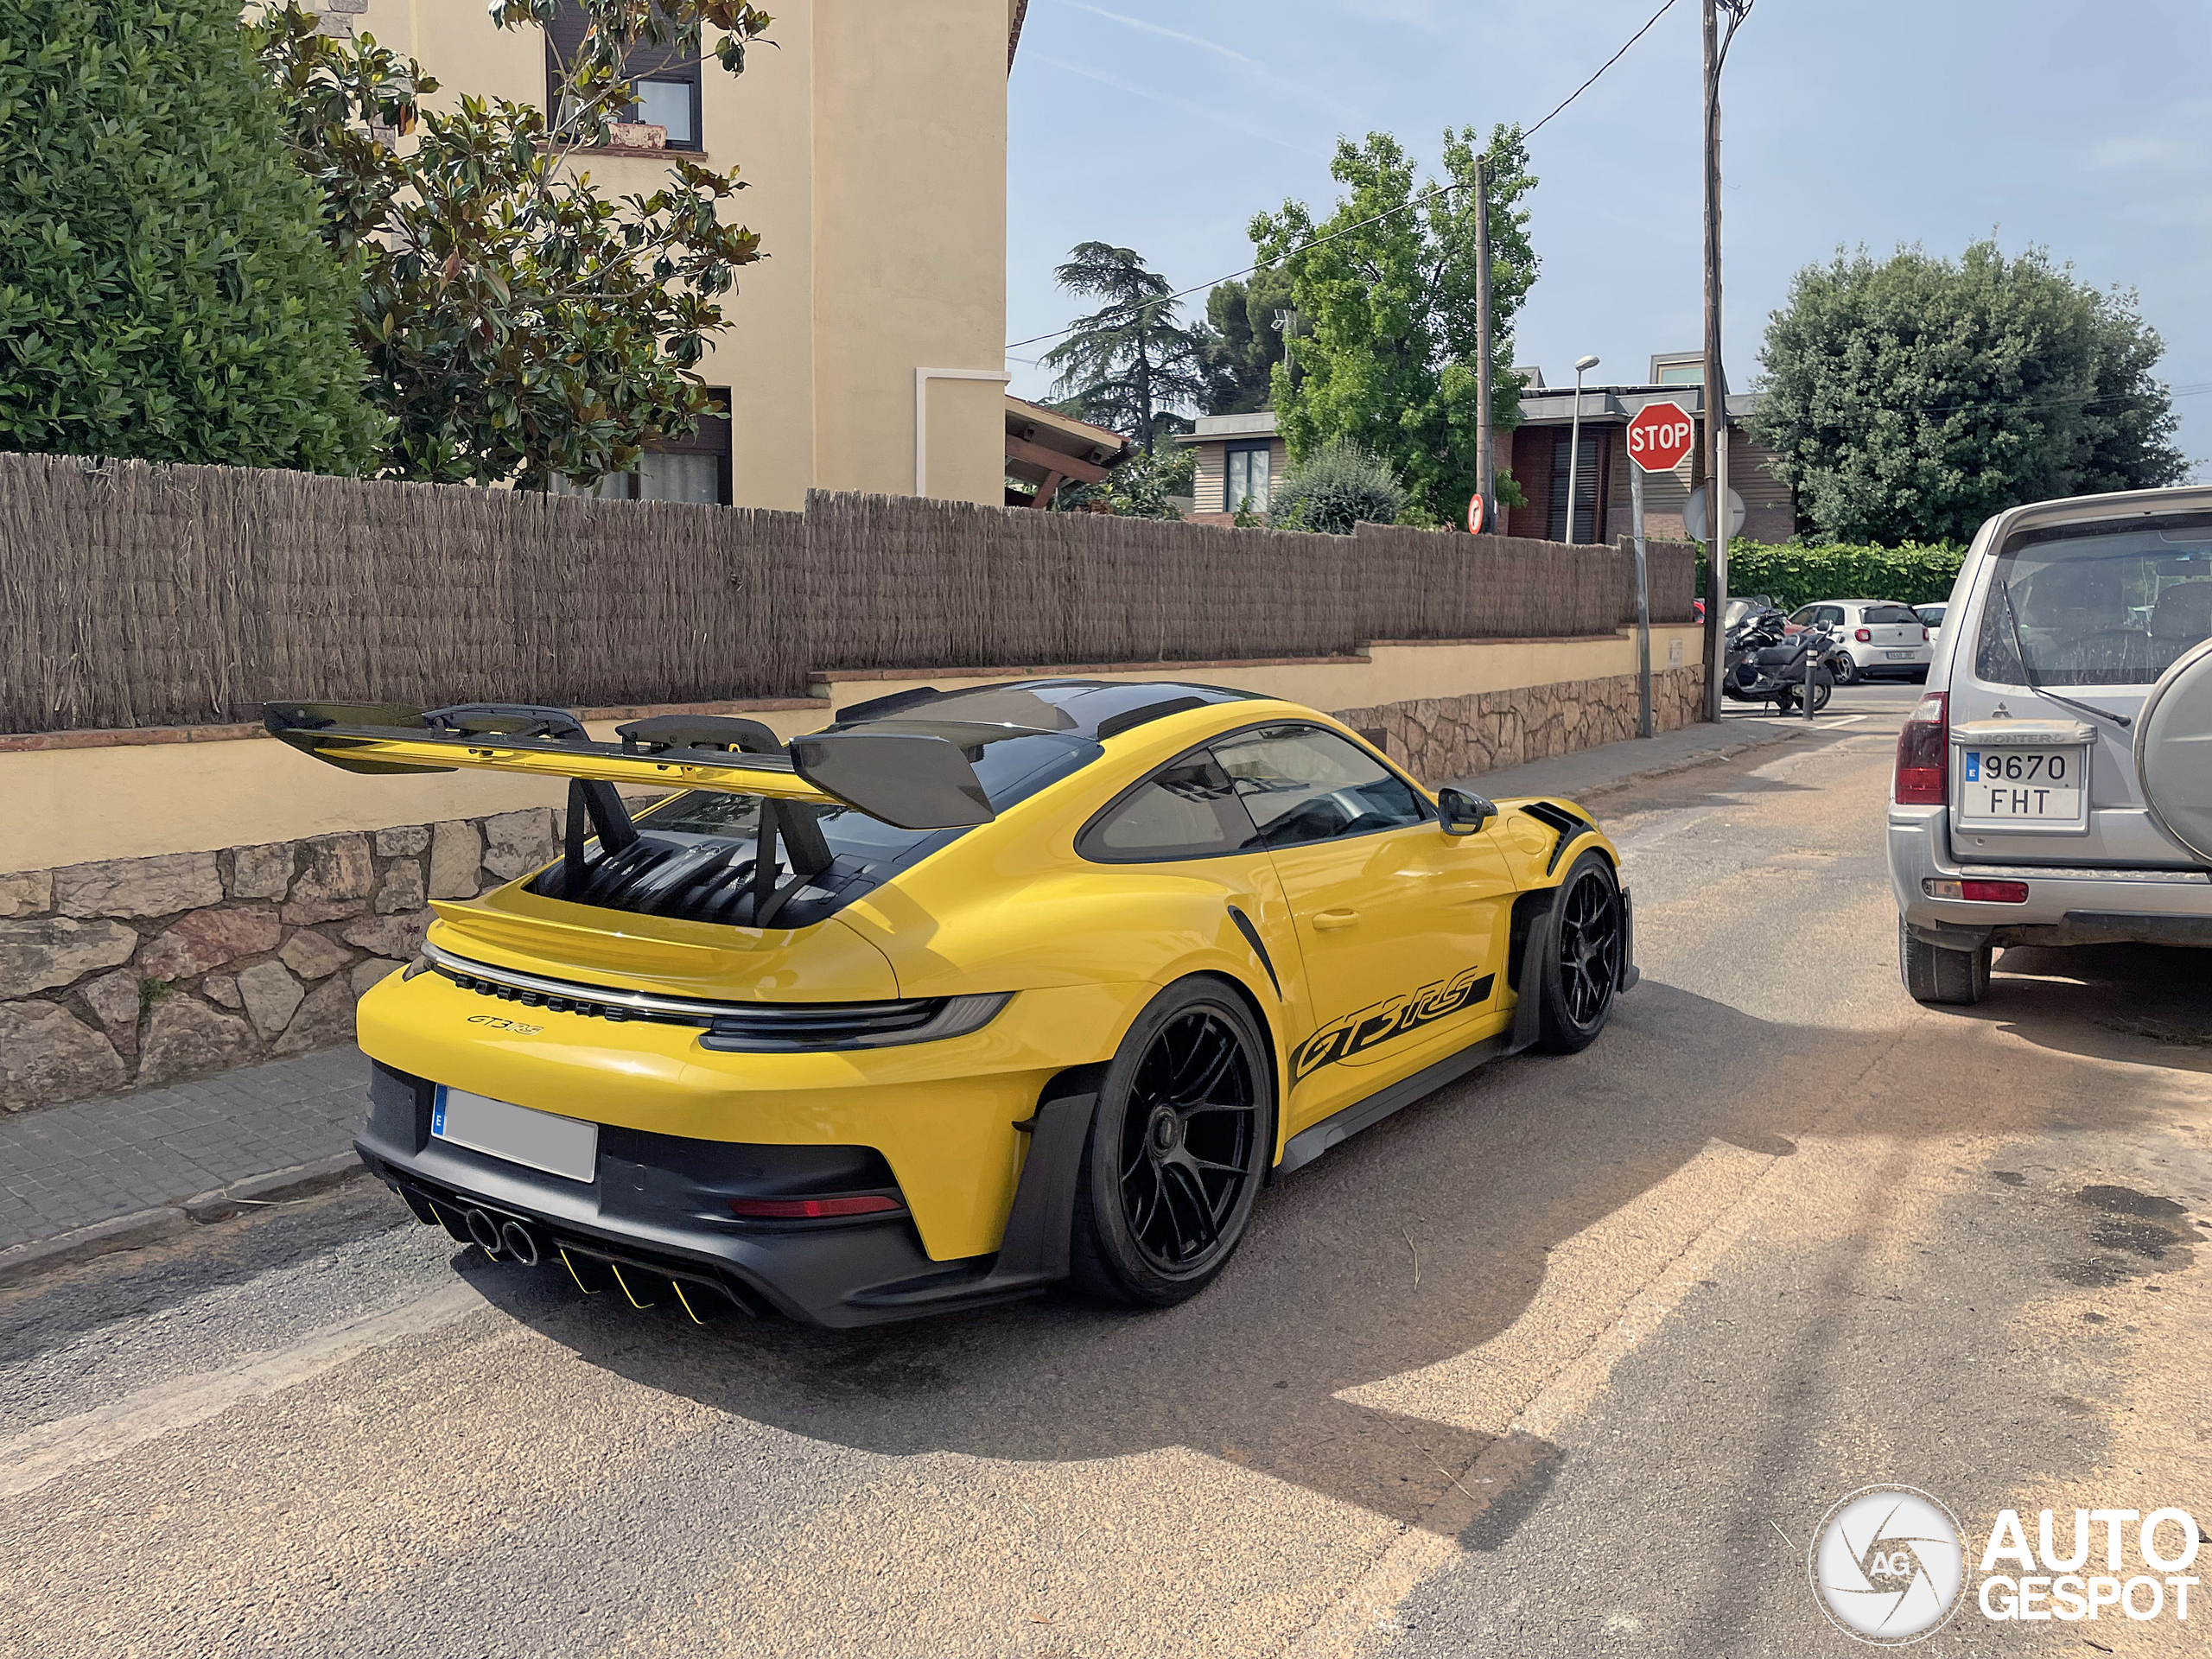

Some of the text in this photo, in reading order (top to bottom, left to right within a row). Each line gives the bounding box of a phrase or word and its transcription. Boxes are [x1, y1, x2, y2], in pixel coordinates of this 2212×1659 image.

[1631, 423, 1688, 453] STOP
[1978, 734, 2066, 743] MONTERO
[1986, 755, 2065, 779] 9670
[1991, 789, 2050, 814] FHT
[435, 1115, 442, 1126] E
